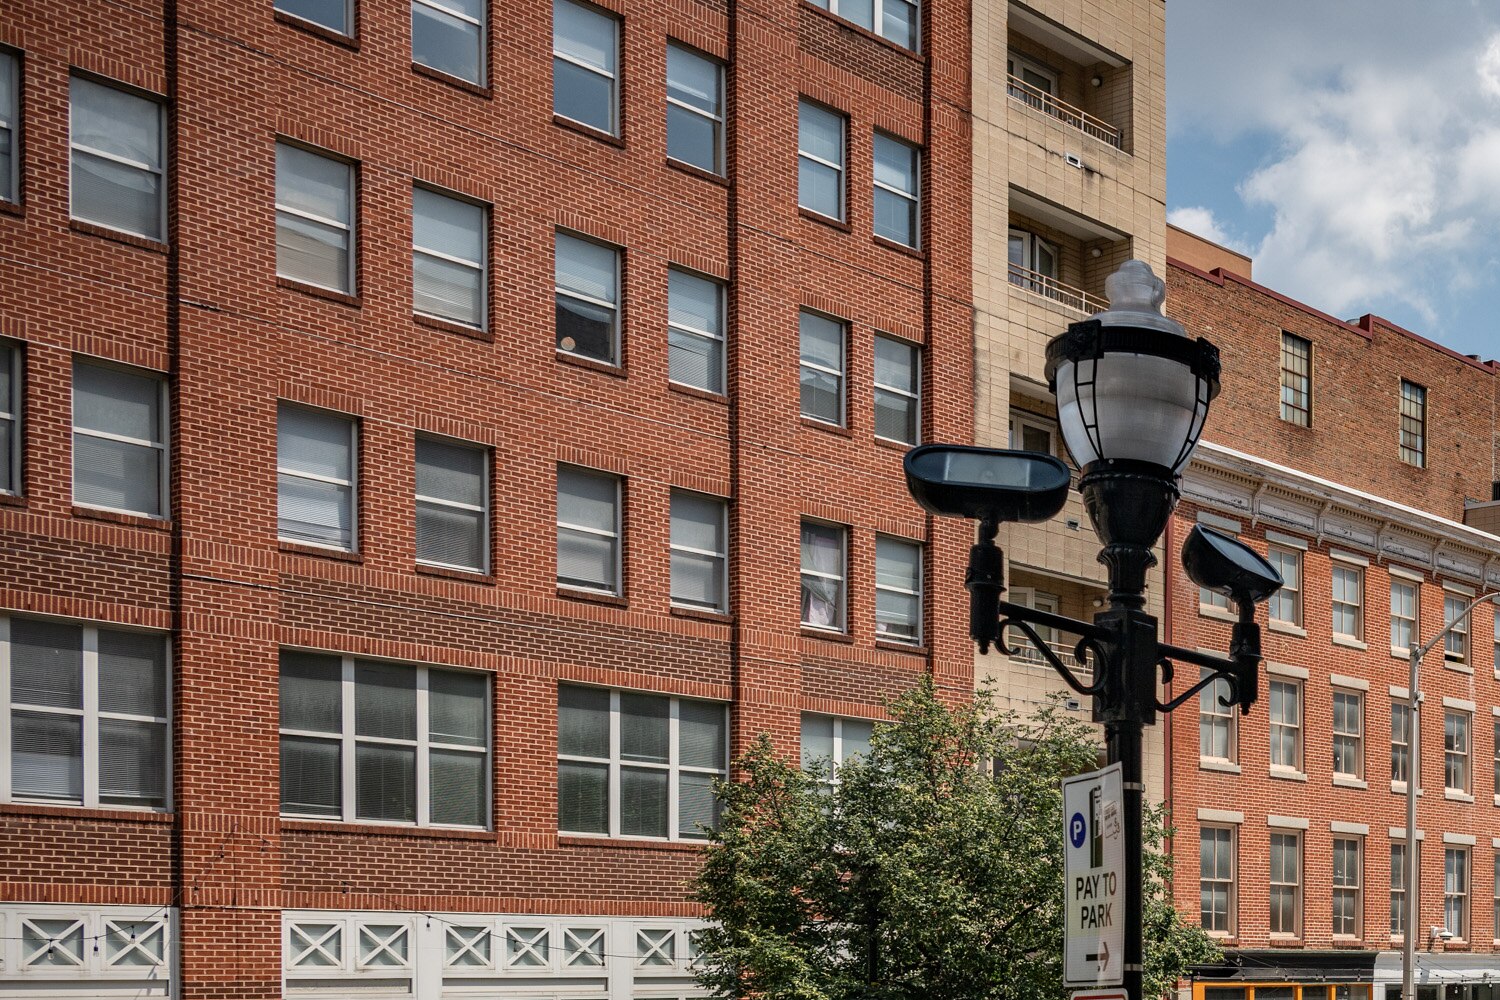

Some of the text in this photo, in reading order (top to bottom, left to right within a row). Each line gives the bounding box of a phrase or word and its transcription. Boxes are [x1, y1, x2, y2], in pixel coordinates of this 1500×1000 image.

[1076, 871, 1117, 900] PAY TO
[1081, 902, 1113, 929] PARK
